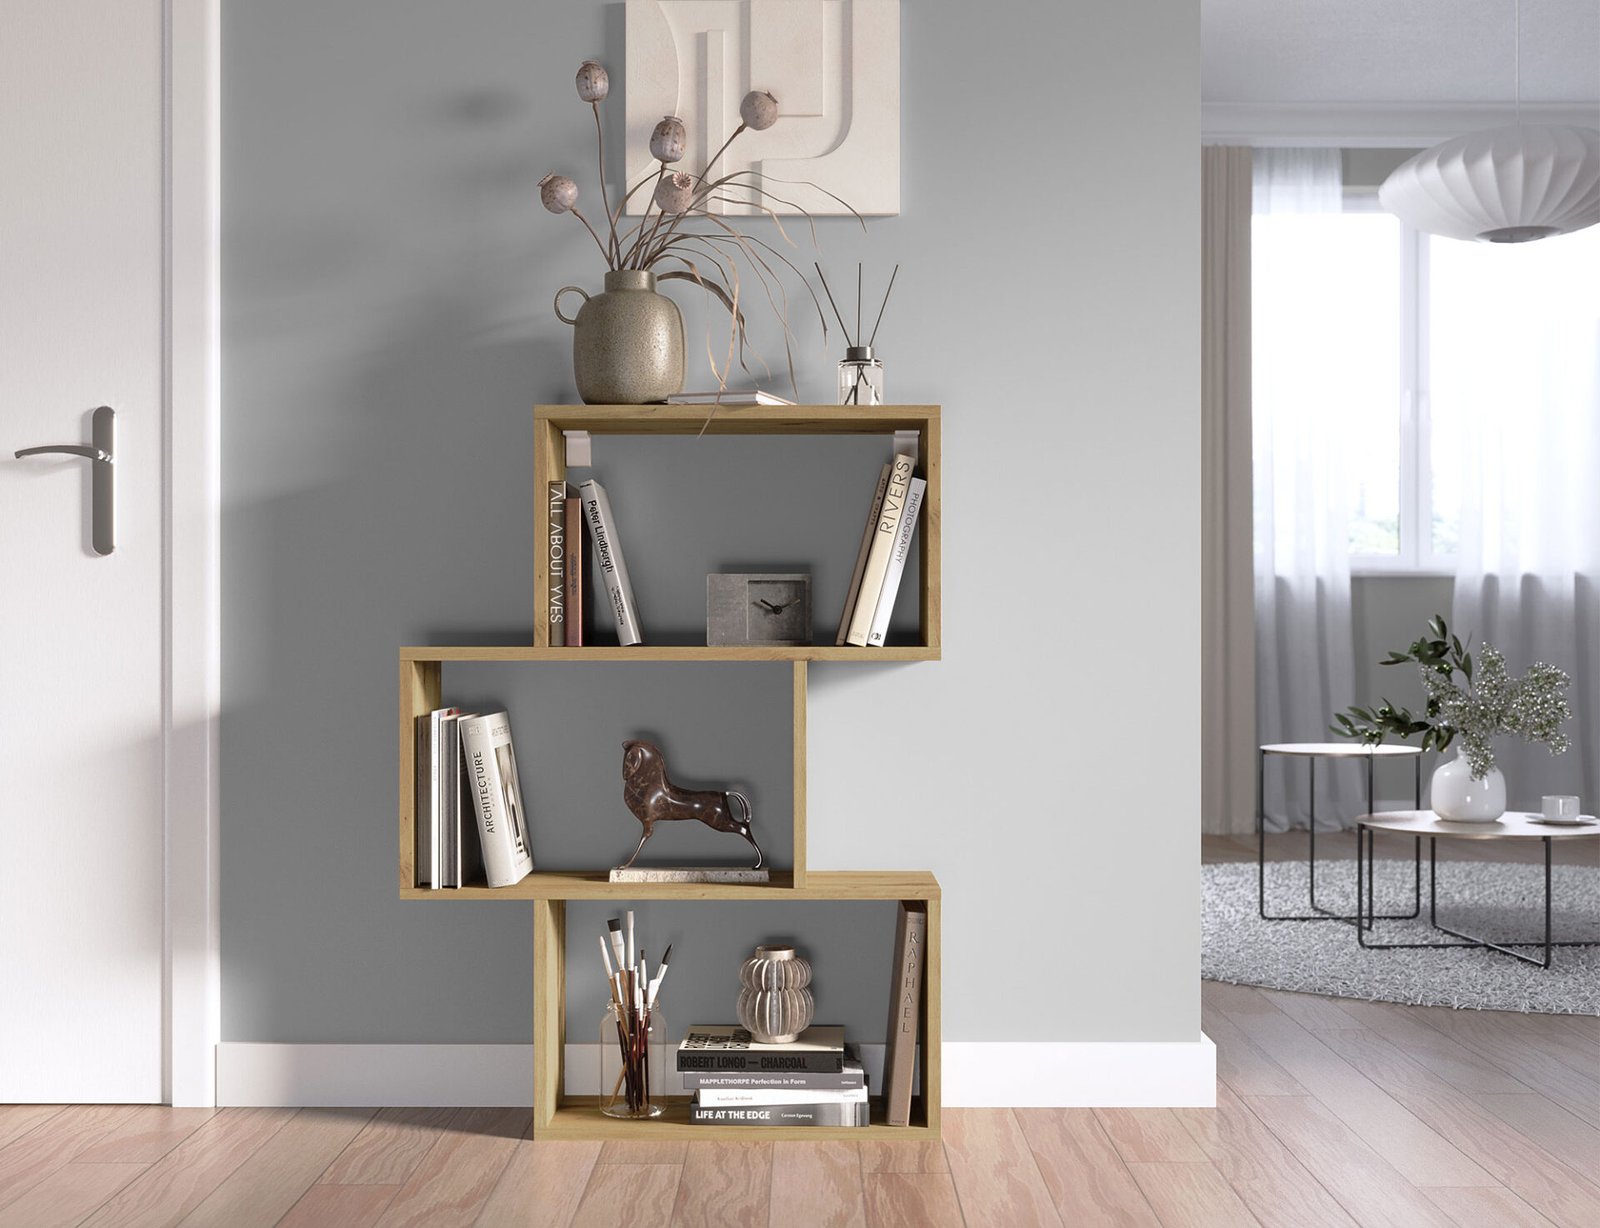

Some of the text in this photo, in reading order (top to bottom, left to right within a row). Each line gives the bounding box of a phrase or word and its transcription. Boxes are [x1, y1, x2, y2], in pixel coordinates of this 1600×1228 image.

[879, 461, 911, 535] RIVERS
[895, 492, 920, 564] PHOTOGRAPHY
[550, 488, 564, 623] ALL ABOUT YVES
[588, 500, 614, 573] Peter Lindbergh
[474, 751, 495, 834] ARCHITECTURE
[902, 931, 919, 1033] RAPHAEL
[680, 1056, 715, 1069] ROBERT
[717, 1056, 746, 1069] LONGO
[761, 1056, 807, 1069] CHARCOAL
[696, 1110, 770, 1119] LIFE AT THE EDGE
